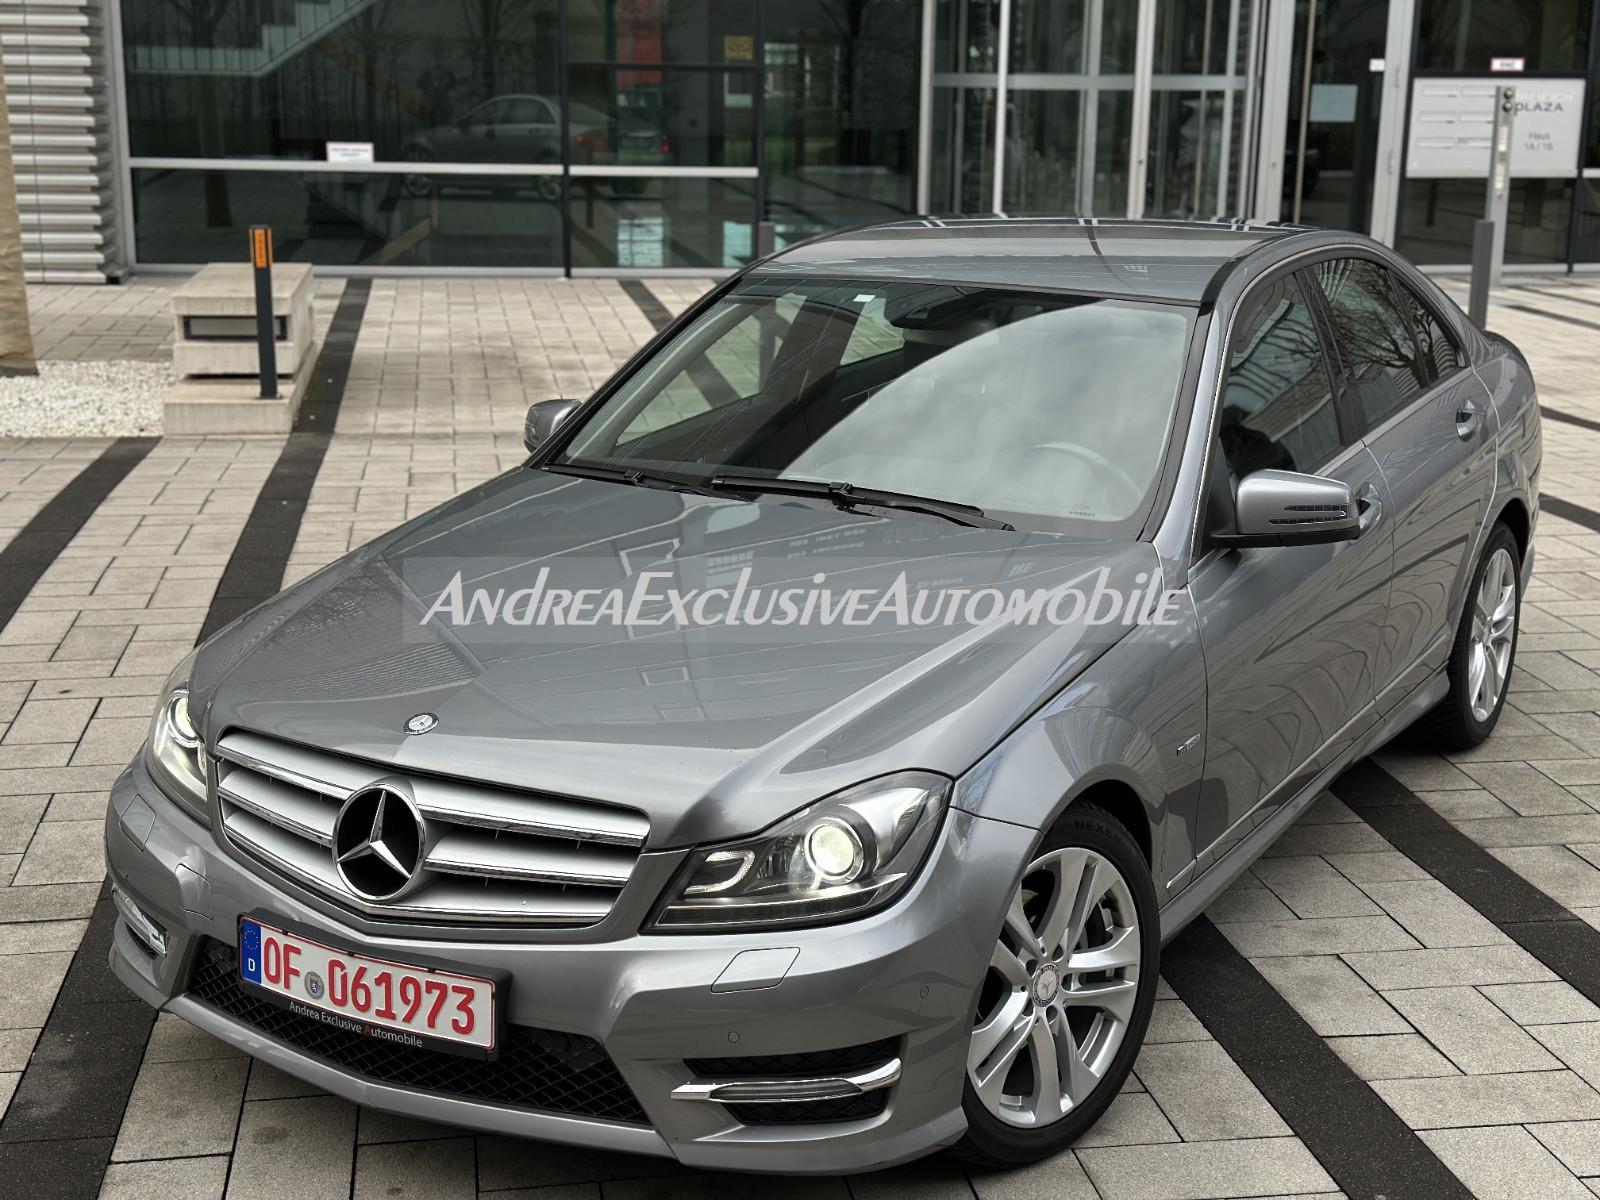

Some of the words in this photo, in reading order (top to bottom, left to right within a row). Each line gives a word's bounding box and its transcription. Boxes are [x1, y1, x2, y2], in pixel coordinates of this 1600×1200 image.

[248, 957, 256, 972] D
[263, 937, 302, 990] OF
[328, 959, 475, 1035] 061973
[289, 1001, 320, 1020] Andrea
[321, 1012, 362, 1033] Exclusive
[362, 1025, 423, 1048] Automobile
